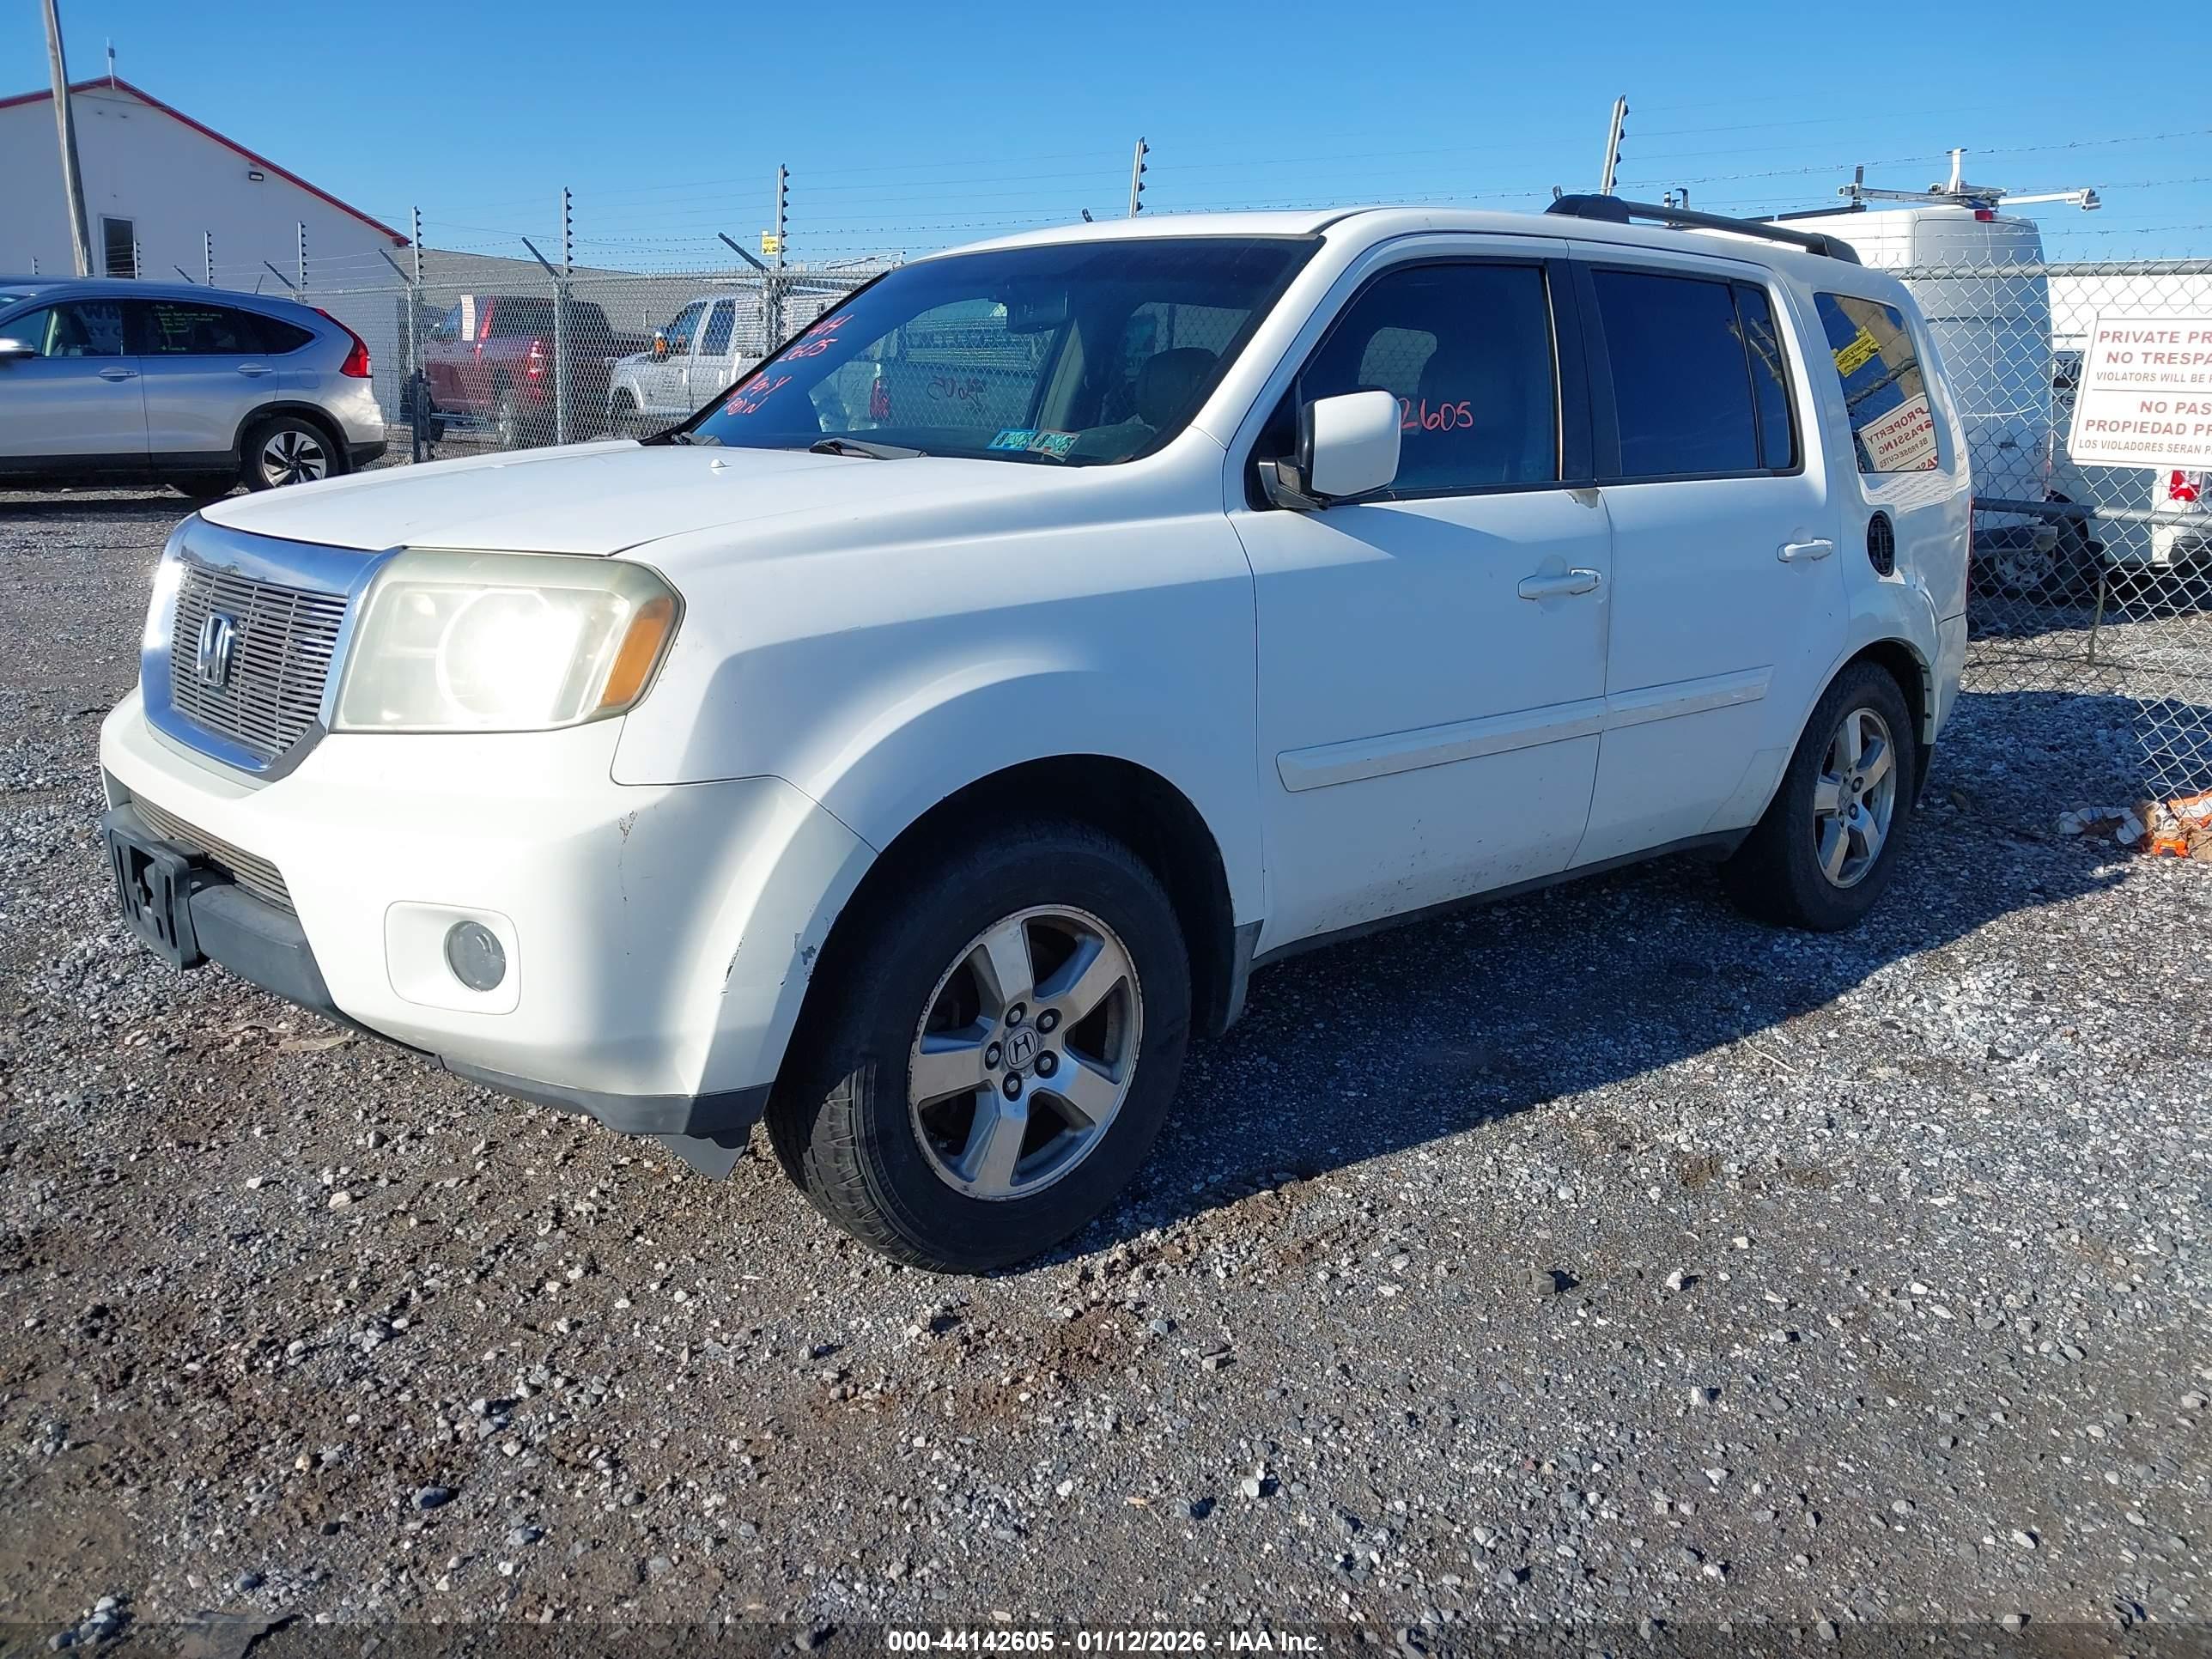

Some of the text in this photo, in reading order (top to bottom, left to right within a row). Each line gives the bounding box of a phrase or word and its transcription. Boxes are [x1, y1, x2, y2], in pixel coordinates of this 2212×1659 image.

[2099, 331, 2212, 343] PRIVATE PR
[2106, 351, 2134, 364] NO
[2097, 372, 2157, 382] VIOLATORS
[2160, 373, 2186, 383] WILL
[2191, 373, 2205, 383] BE
[1398, 398, 1475, 432] 2605
[2140, 400, 2212, 416] NO PAS
[2085, 418, 2187, 435] PROPIEDAD
[2078, 439, 2098, 449] LOS
[2100, 440, 2164, 453] VIOLADORES
[2166, 443, 2202, 454] SERAN
